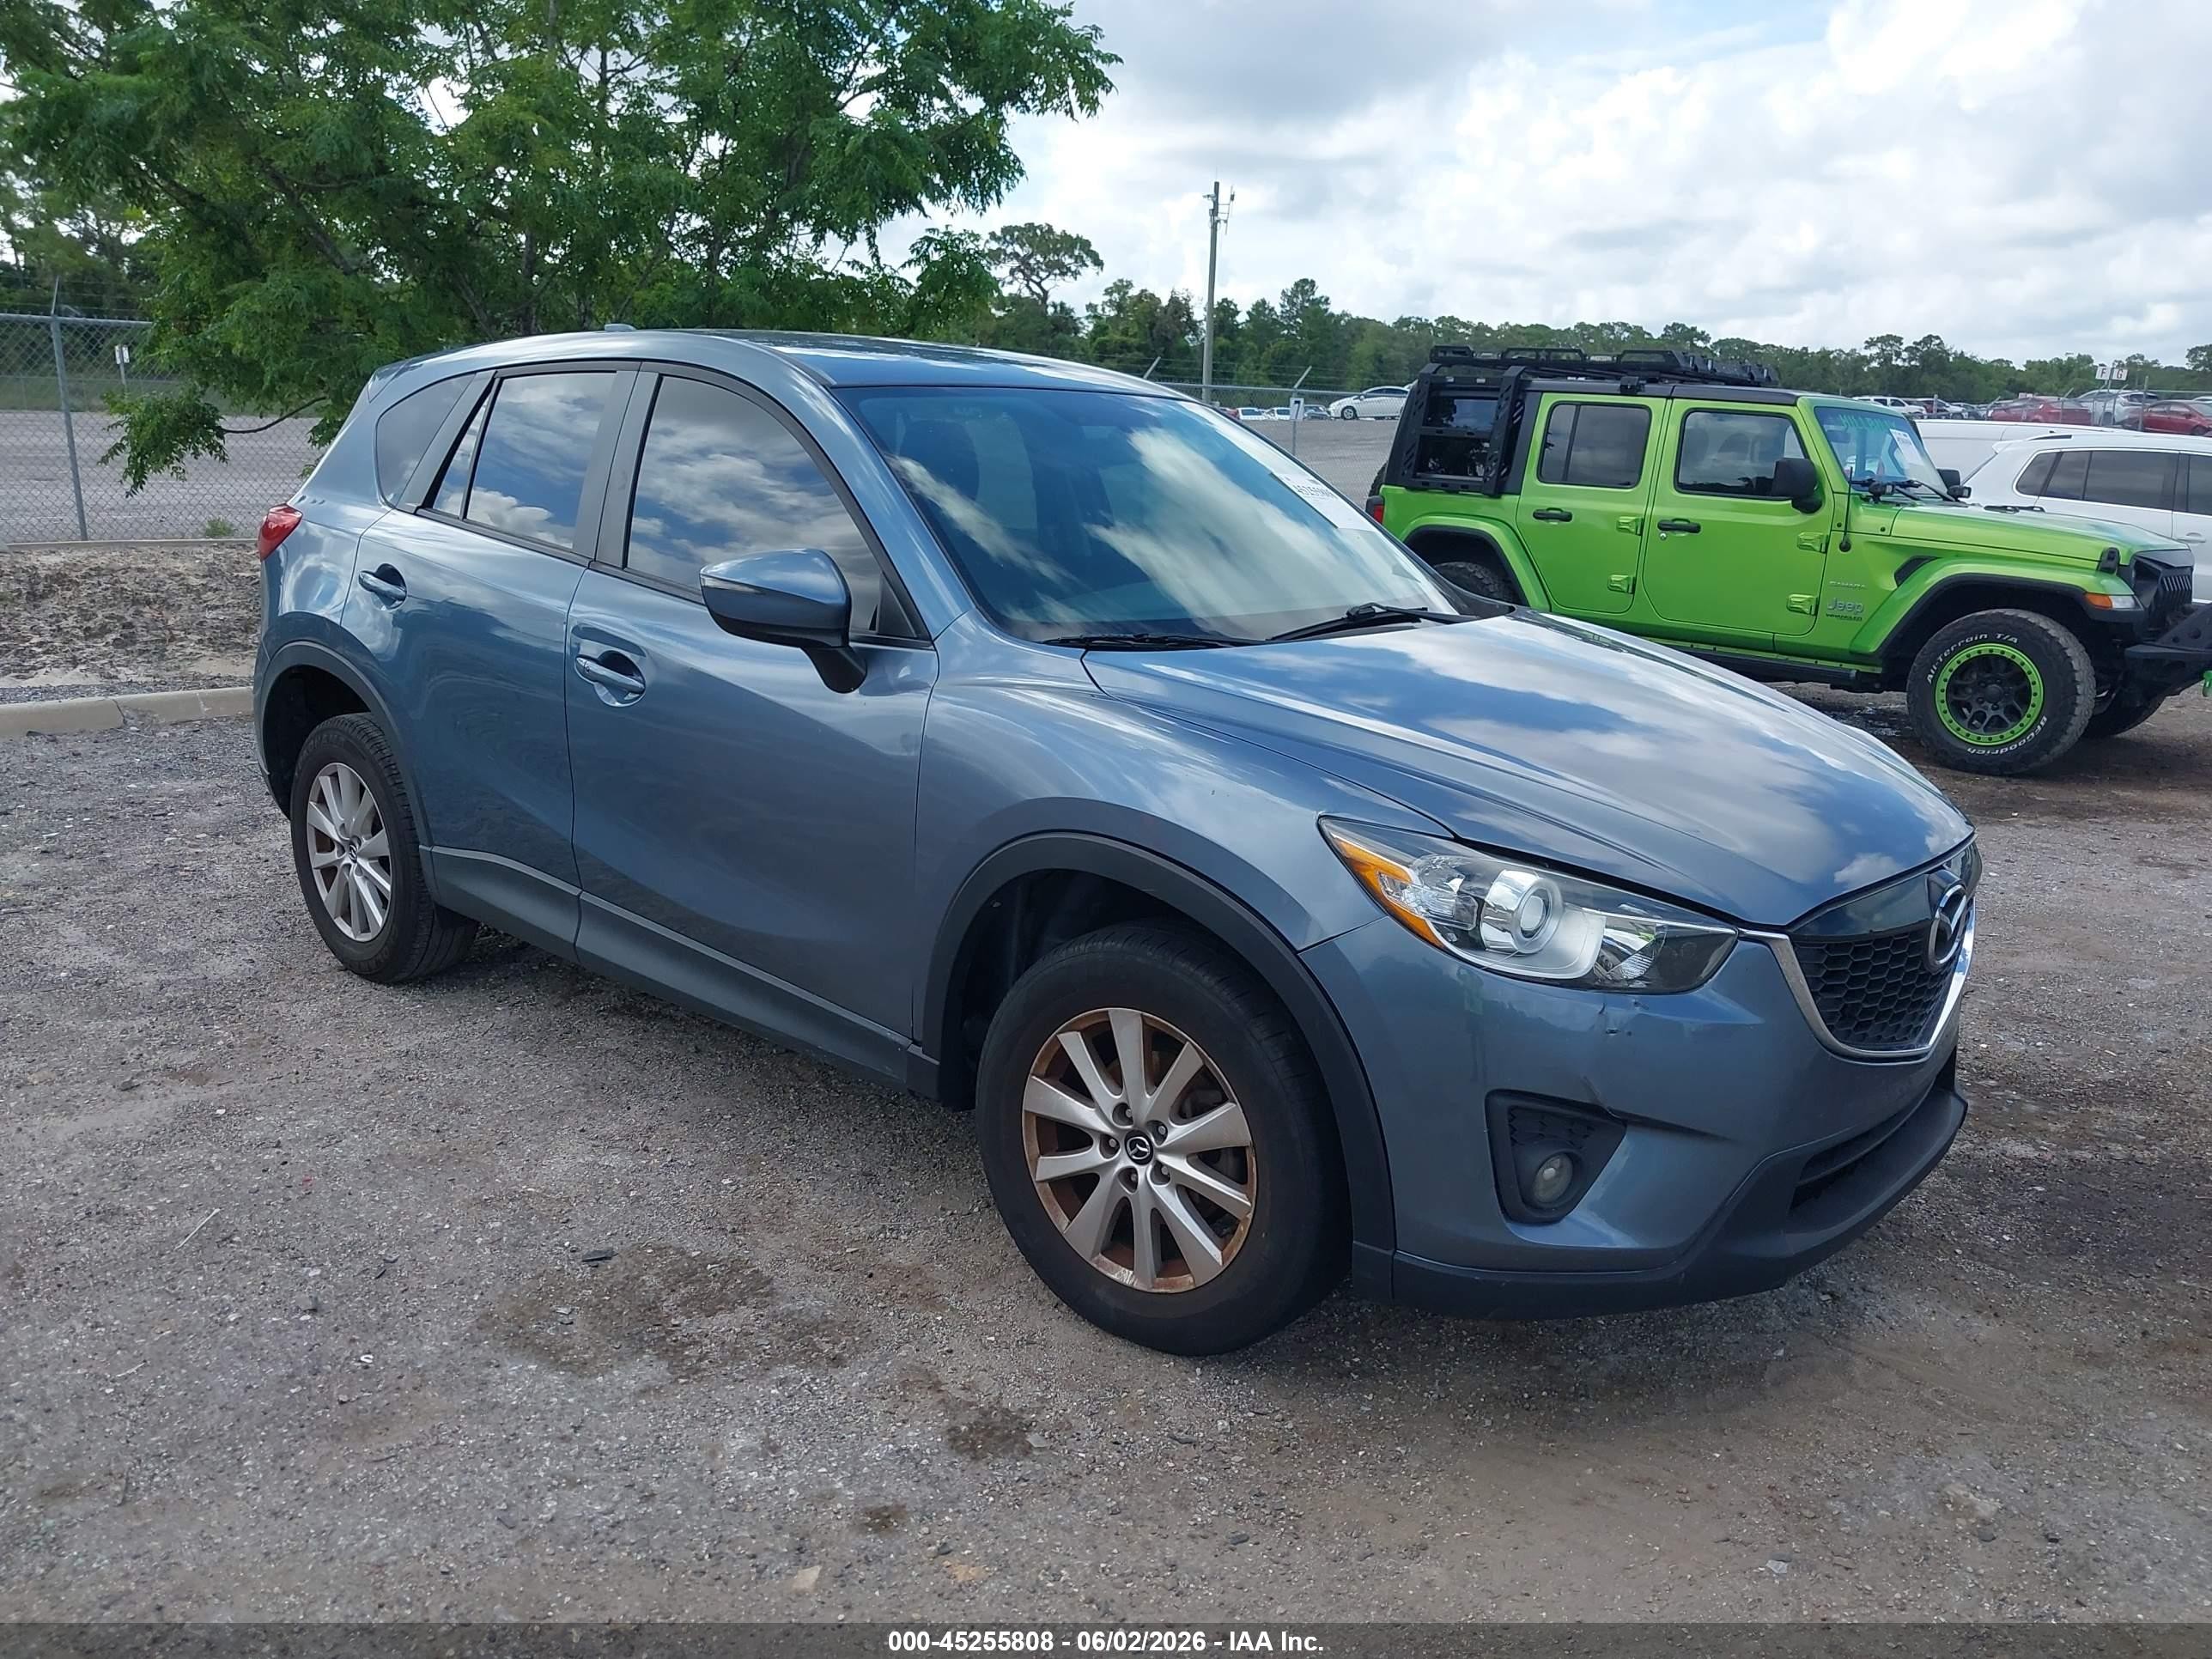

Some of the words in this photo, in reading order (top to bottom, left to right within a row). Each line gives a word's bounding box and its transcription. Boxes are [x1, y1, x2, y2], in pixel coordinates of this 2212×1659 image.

[2100, 368, 2107, 378] F
[2116, 369, 2124, 379] G
[1294, 400, 1301, 419] 7
[1827, 598, 1863, 615] Jeep
[1926, 634, 1988, 684] All-Terrain
[1996, 633, 2018, 644] T/A
[1966, 715, 2048, 756] BFGoodrich
